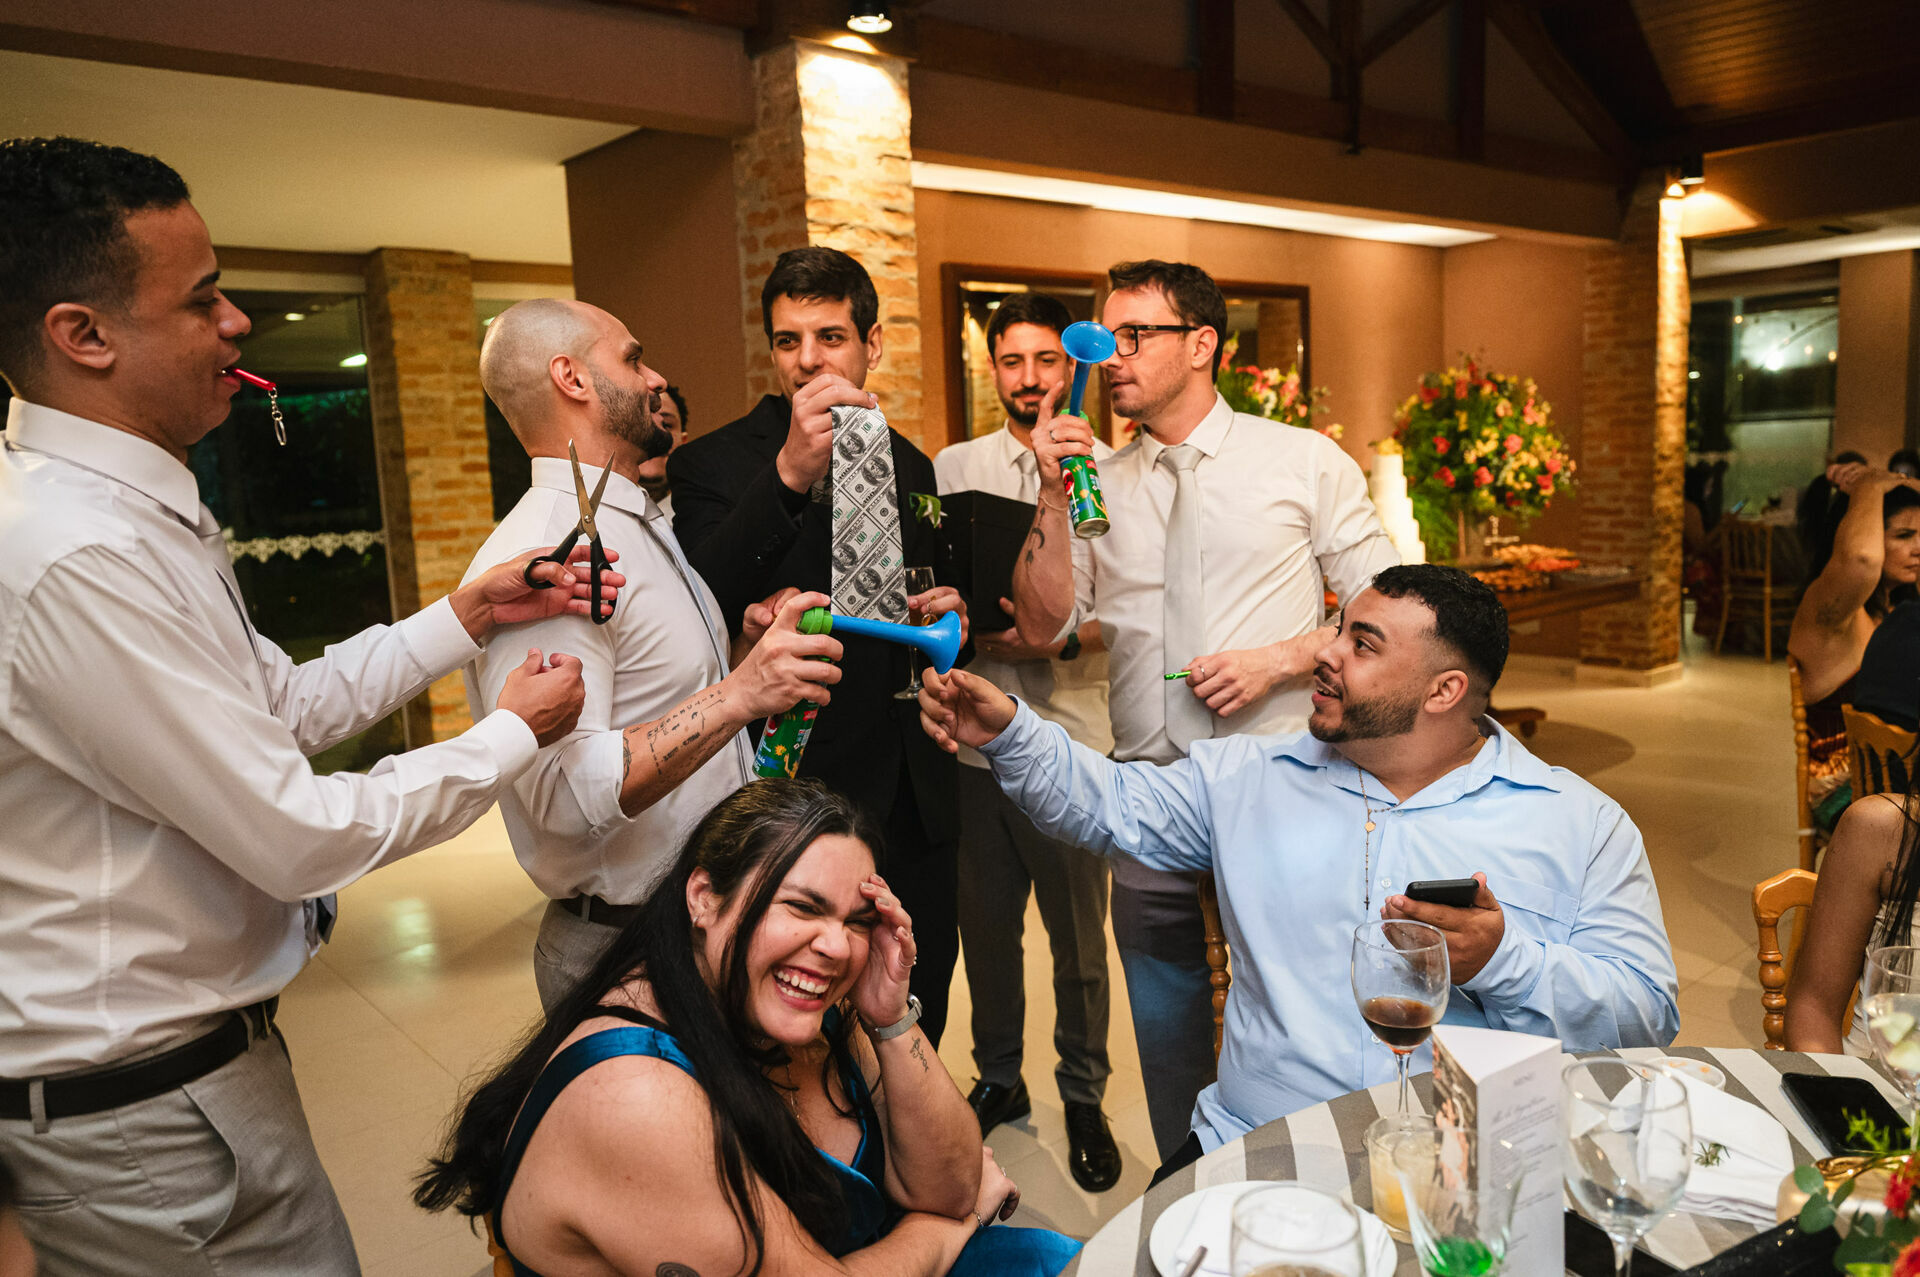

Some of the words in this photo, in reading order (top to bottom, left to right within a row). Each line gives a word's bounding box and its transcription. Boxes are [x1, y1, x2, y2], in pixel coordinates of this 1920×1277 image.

[863, 491, 875, 504] 100
[855, 531, 868, 545] 100
[878, 555, 892, 570] 100
